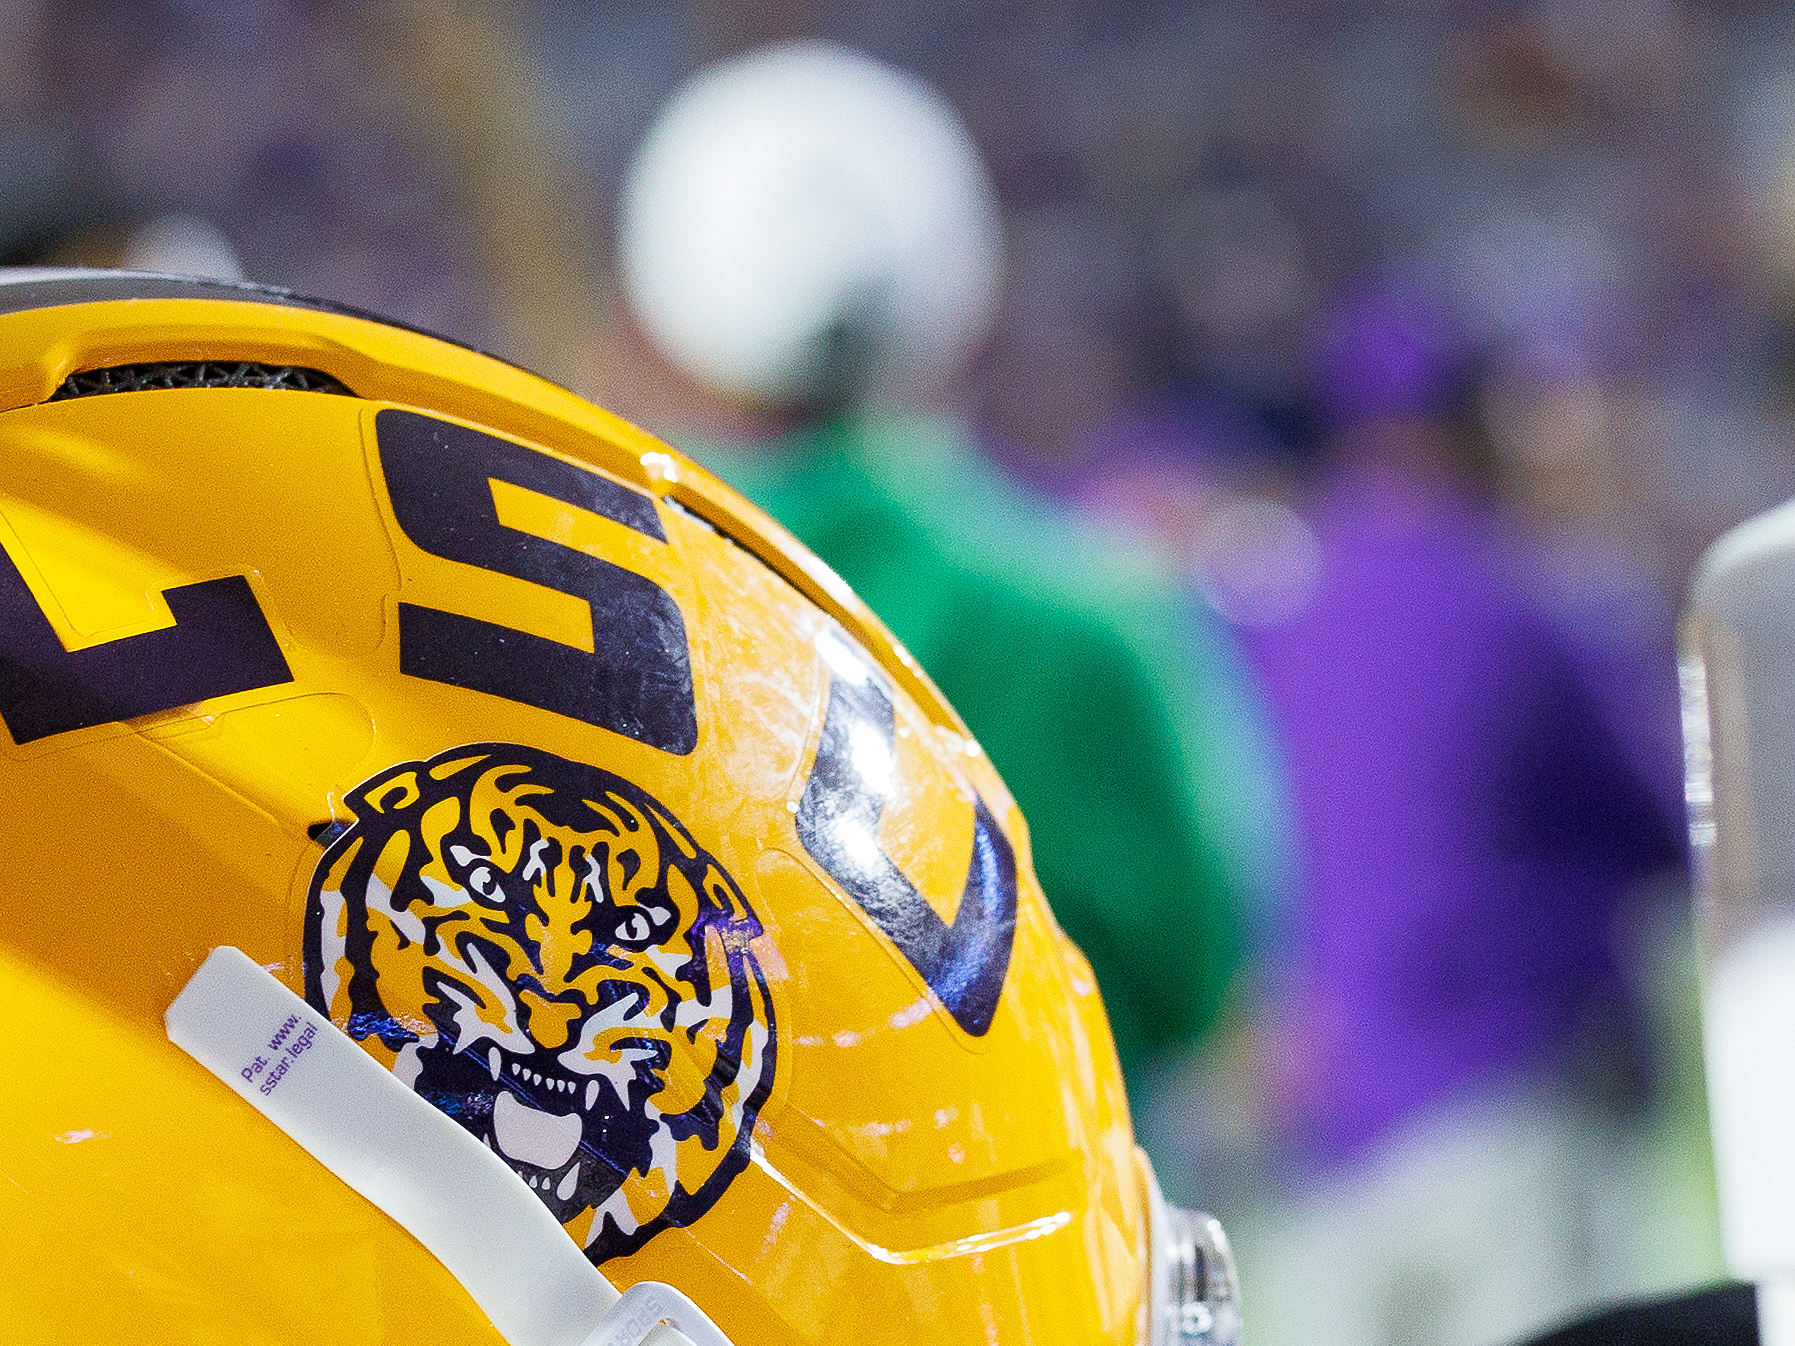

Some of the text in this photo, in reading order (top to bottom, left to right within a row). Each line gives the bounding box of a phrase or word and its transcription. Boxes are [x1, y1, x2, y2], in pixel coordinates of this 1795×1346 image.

[241, 1014, 302, 1083] Pat. www.
[260, 1021, 318, 1096] sstar.legal
